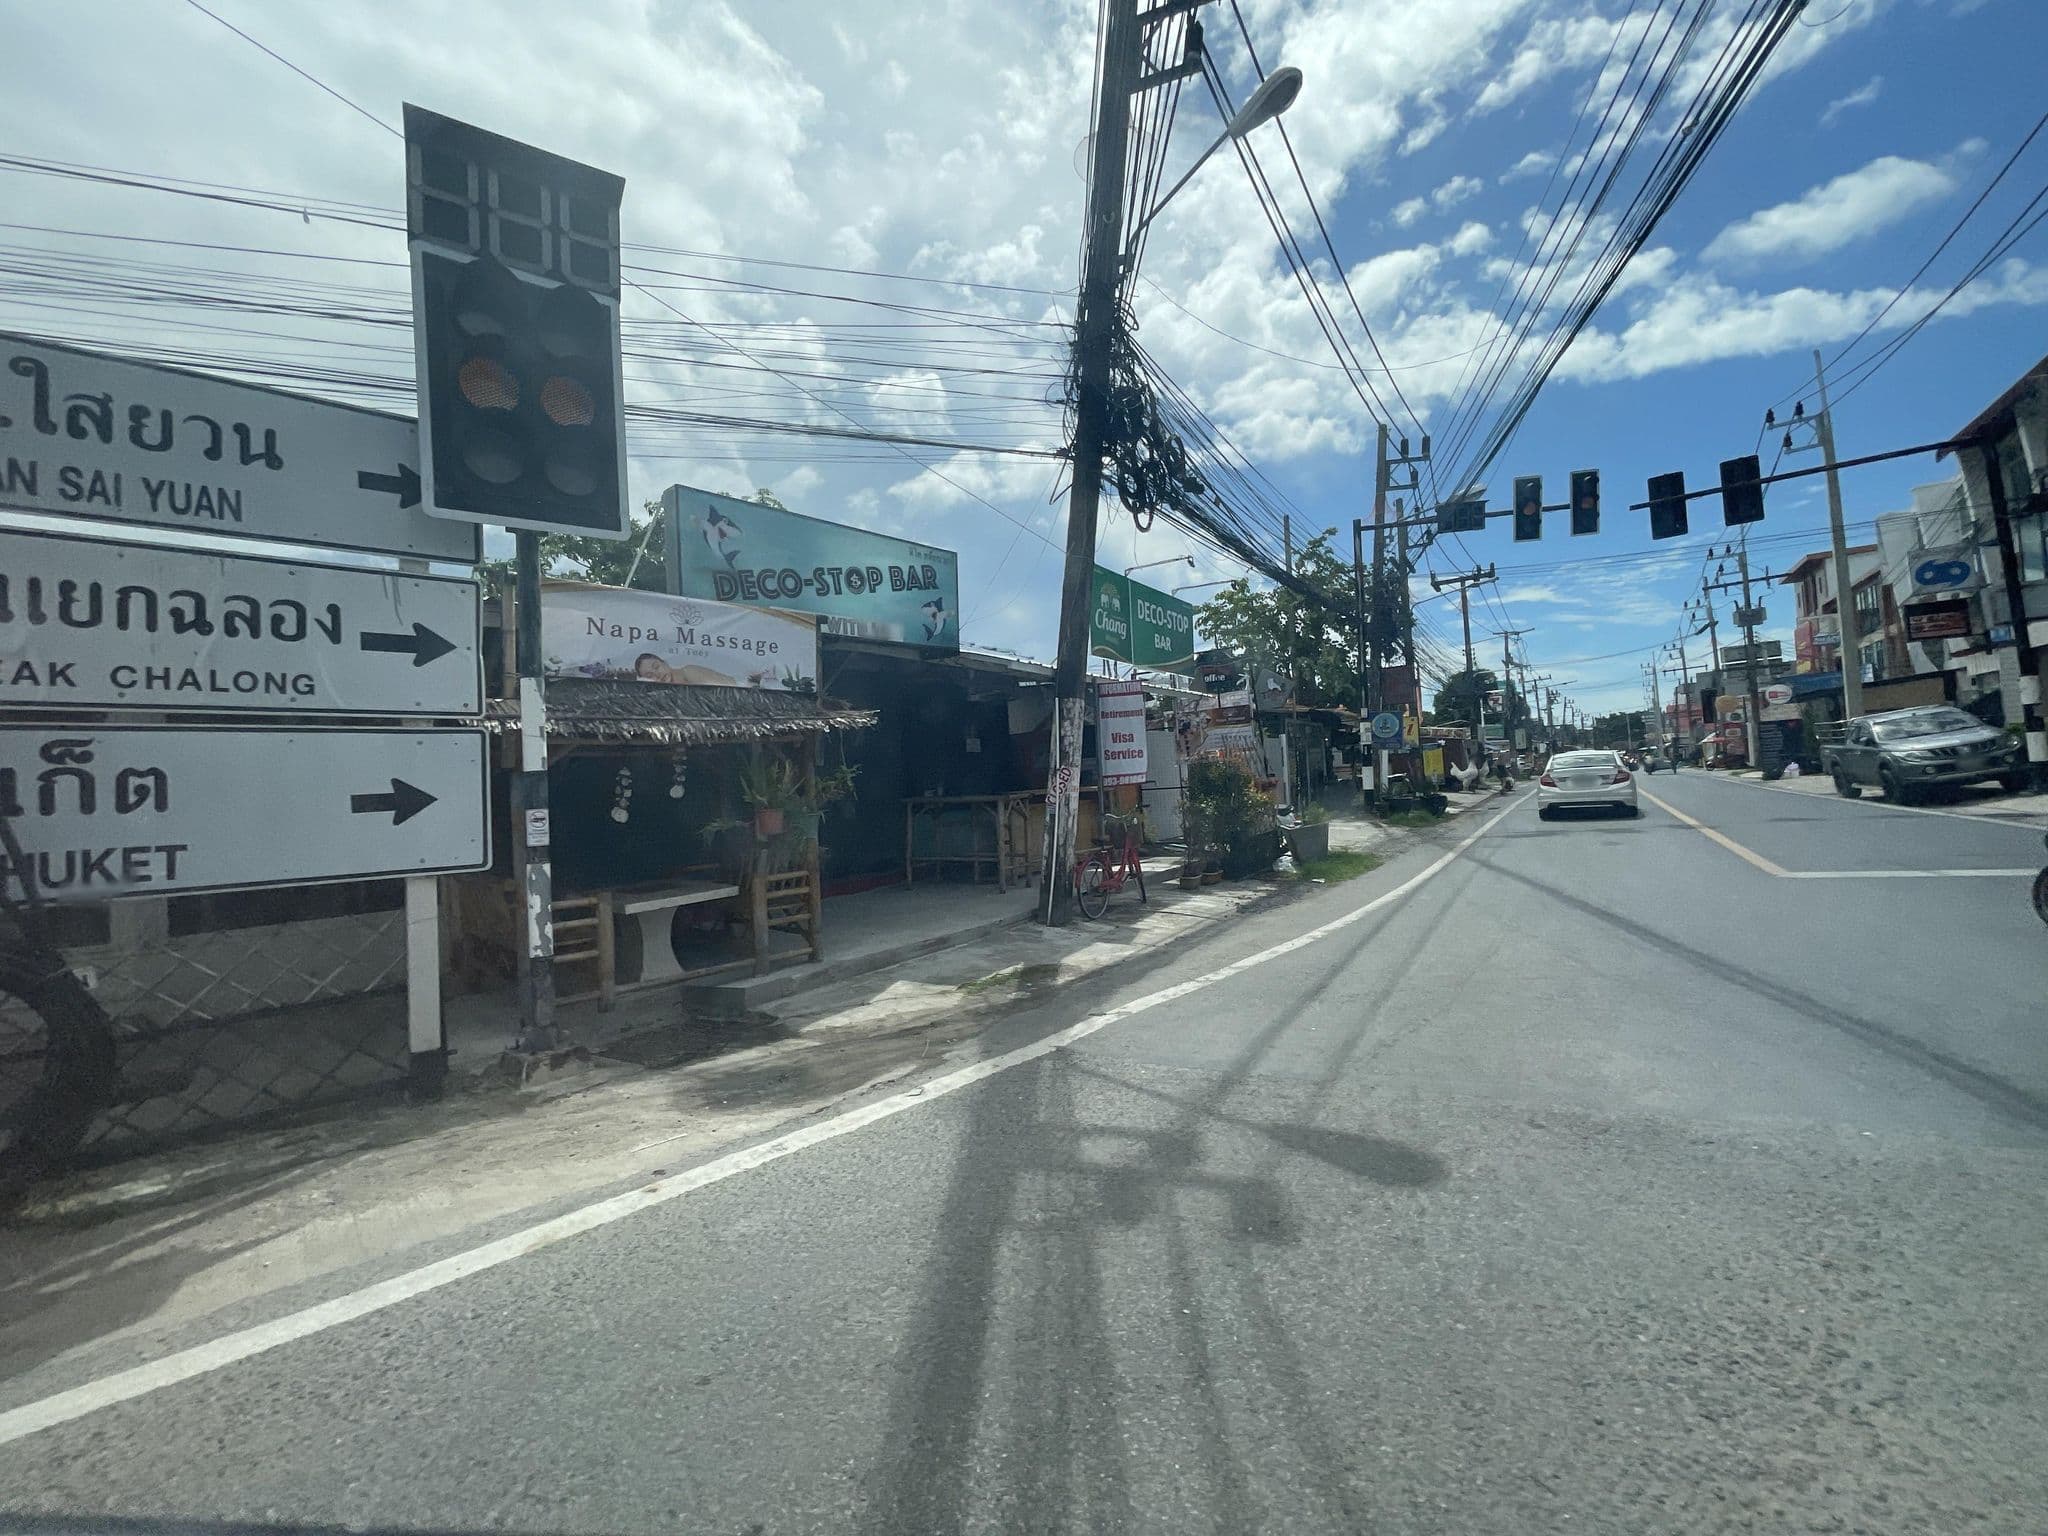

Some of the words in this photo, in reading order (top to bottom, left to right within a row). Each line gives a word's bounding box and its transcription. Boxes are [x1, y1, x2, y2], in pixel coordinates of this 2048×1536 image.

[0, 356, 284, 471] ใสยวน
[57, 466, 122, 507] SAI
[140, 476, 242, 522] YUAN
[712, 566, 884, 602] DECO-STOP
[887, 564, 939, 592] BAR
[1095, 608, 1127, 640] Chang
[1137, 599, 1189, 634] DECO-STOP
[586, 617, 660, 644] Napa
[675, 626, 779, 657] Massage
[1154, 633, 1172, 652] BAR
[0, 660, 77, 688] AK
[109, 665, 316, 696] CHALONG
[1101, 708, 1143, 719] Retirement
[1111, 731, 1135, 743] Visa
[1104, 749, 1144, 761] Service
